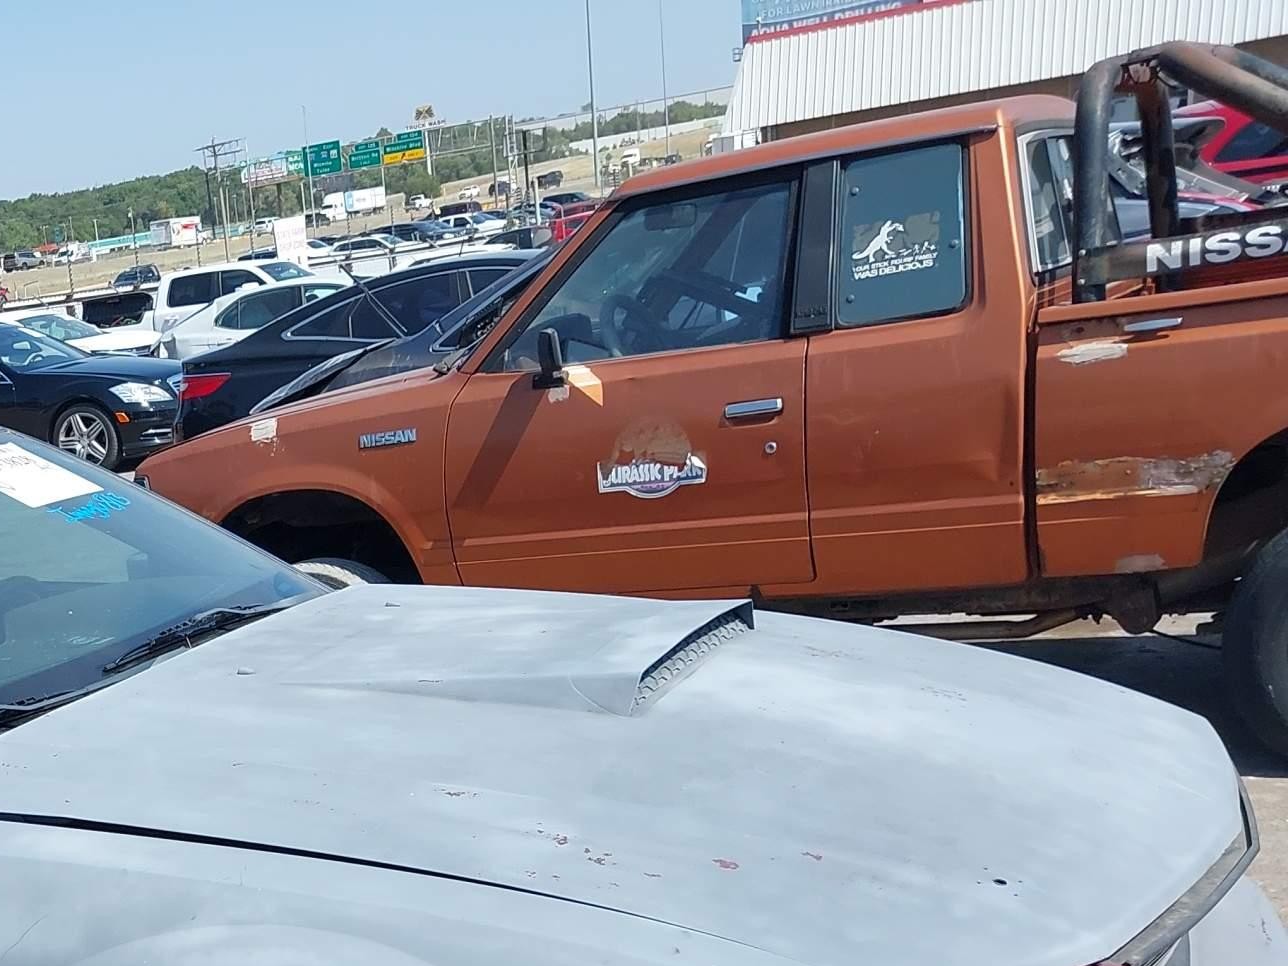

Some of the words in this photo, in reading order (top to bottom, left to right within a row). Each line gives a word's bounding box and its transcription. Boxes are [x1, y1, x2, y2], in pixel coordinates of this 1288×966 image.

[762, 7, 782, 18] FOR
[786, 0, 820, 14] LAWN
[915, 252, 938, 260] FAMILY
[1146, 225, 1288, 273] NISS
[854, 269, 878, 280] WAS
[879, 260, 933, 276] DELICIOUS
[359, 428, 416, 449] NISSAN
